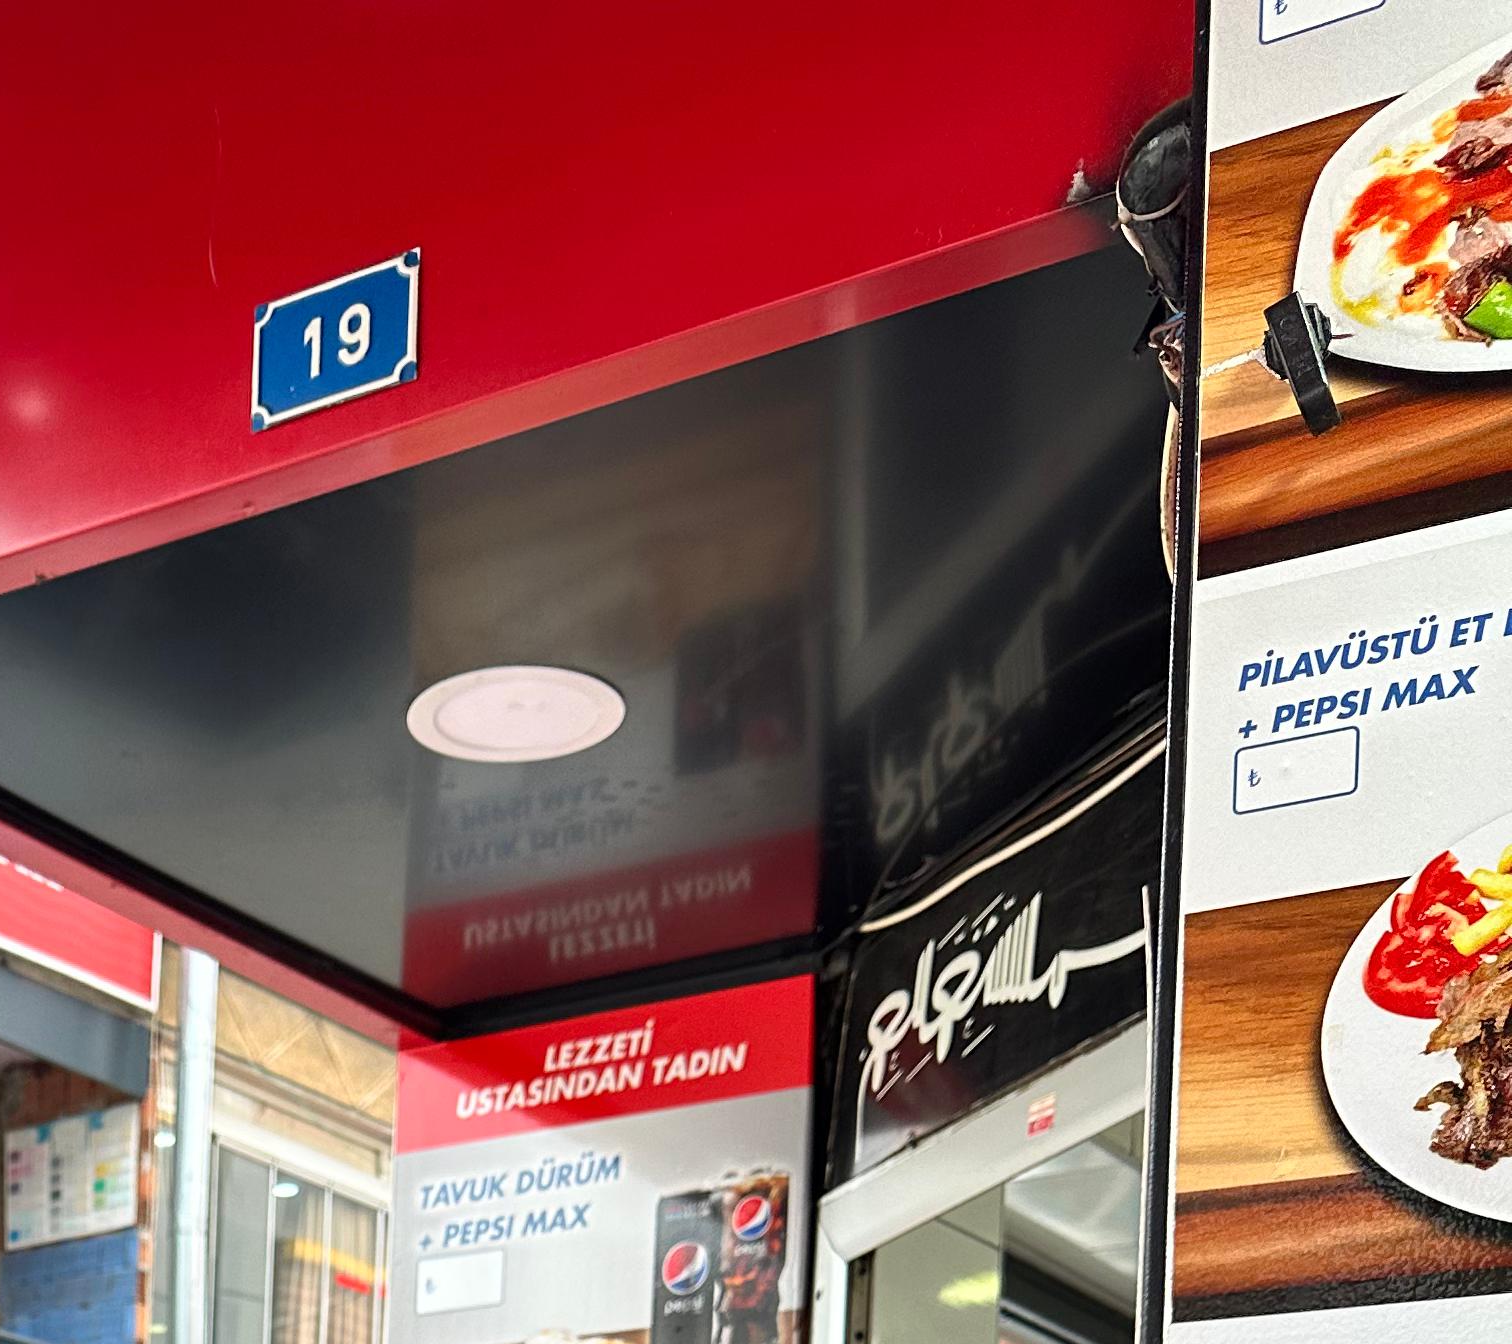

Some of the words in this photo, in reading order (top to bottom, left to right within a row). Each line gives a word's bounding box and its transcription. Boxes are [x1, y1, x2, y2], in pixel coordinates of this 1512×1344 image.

[304, 303, 371, 379] 19
[1238, 614, 1439, 691] PİLAVÜSTÜ
[1450, 612, 1493, 648] ET
[1238, 719, 1258, 739] +
[1271, 687, 1373, 734] PEPSI
[1381, 664, 1480, 712] MAX
[456, 1060, 645, 1119] USTASINDAN
[651, 1041, 748, 1087] TADIN
[544, 1017, 656, 1073] LEZZETİ
[421, 1172, 508, 1210] TAVUK
[515, 1151, 622, 1195] DÜRÜM
[419, 1234, 433, 1250] +
[442, 1214, 514, 1248] PEPSI
[522, 1203, 592, 1238] MAX
